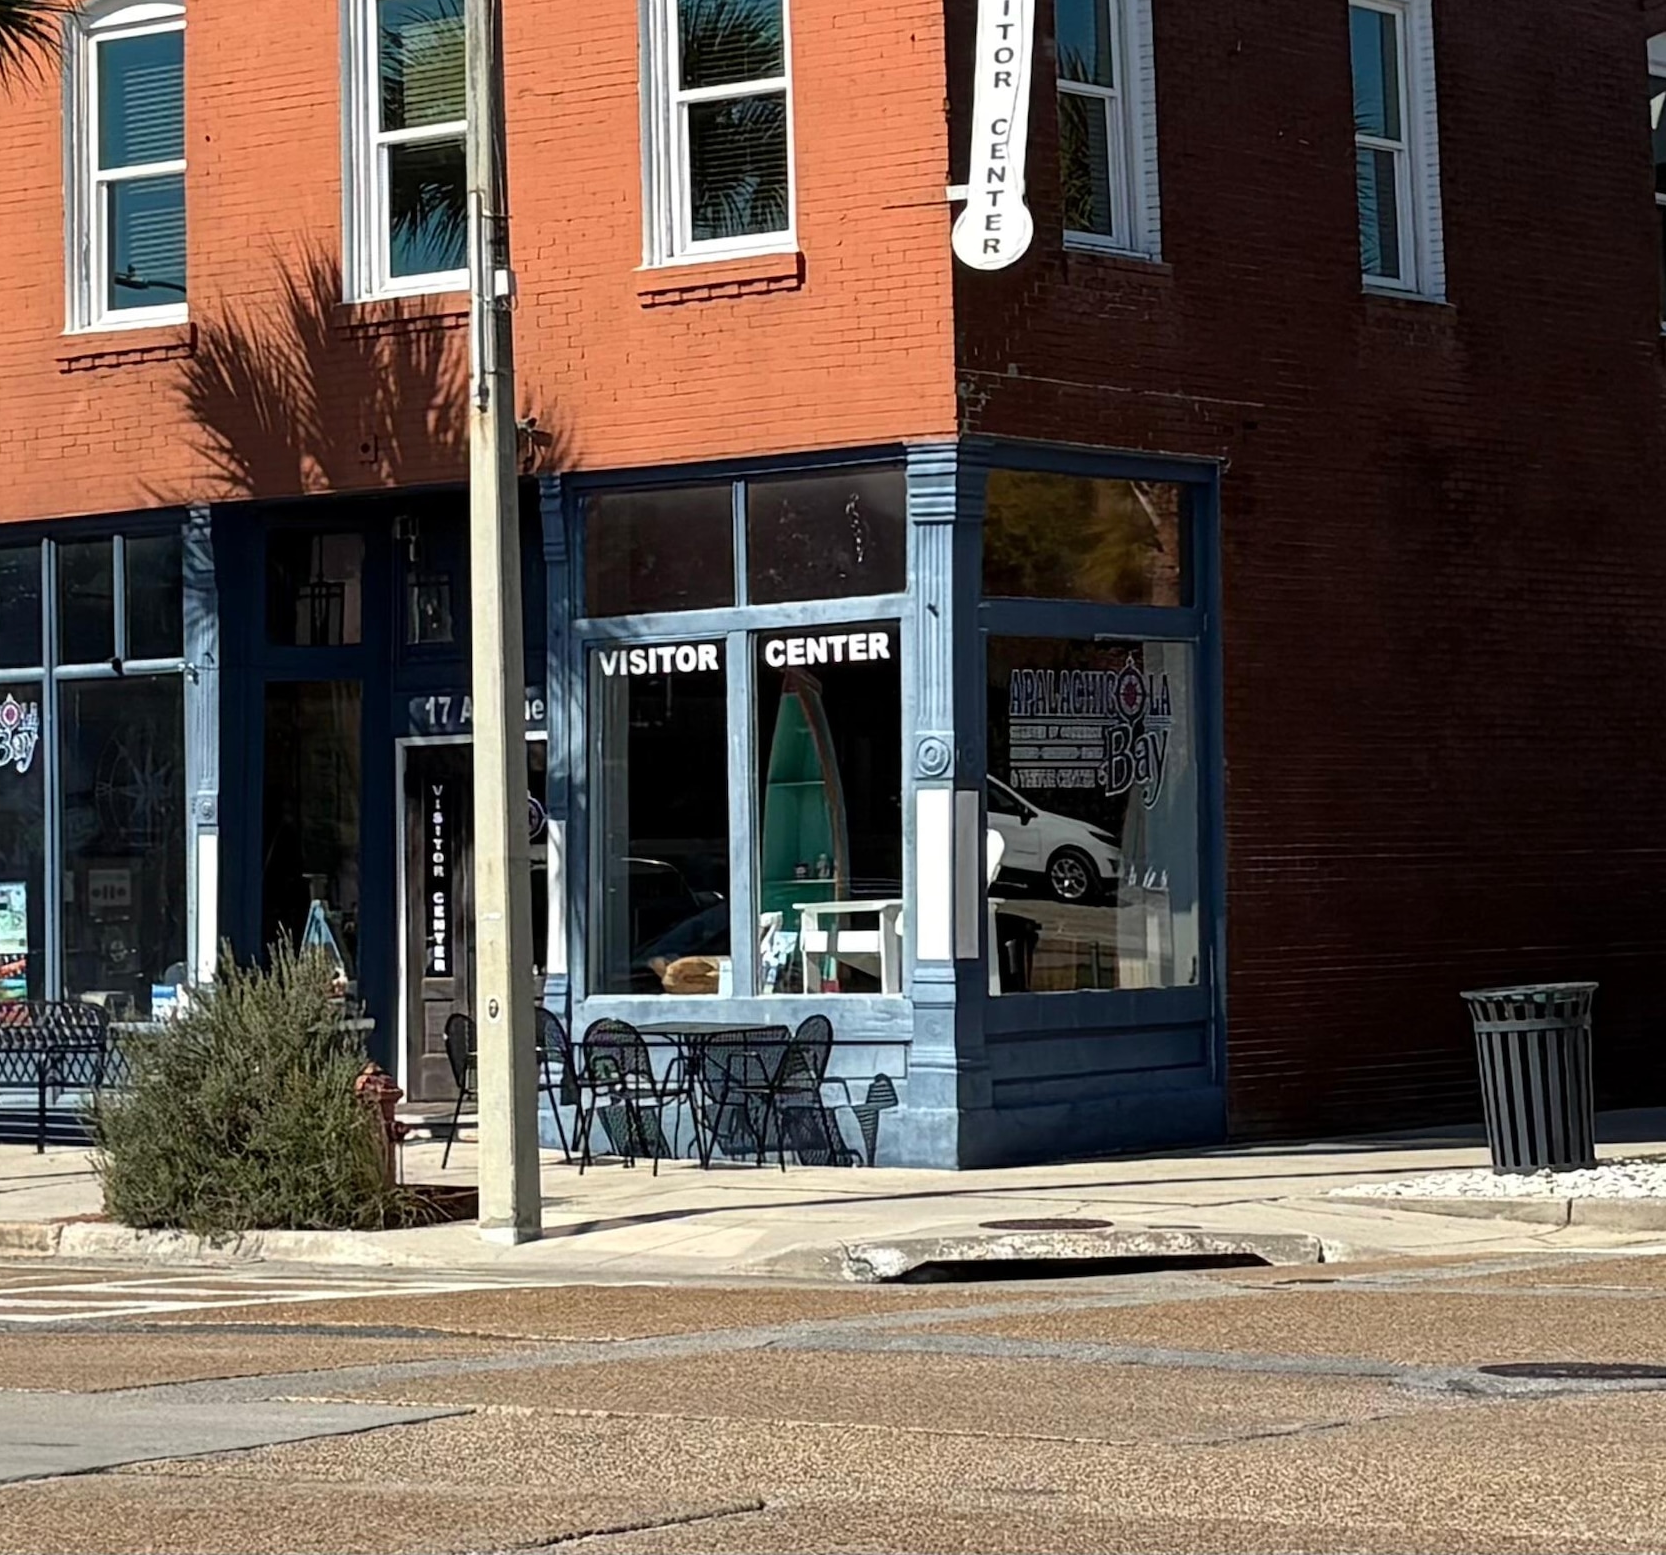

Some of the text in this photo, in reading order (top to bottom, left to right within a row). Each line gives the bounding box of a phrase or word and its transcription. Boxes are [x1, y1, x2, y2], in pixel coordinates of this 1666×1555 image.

[982, 118, 1008, 255] CENTER
[598, 631, 891, 676] VISITOR CENTER
[425, 696, 451, 725] 17
[1099, 724, 1170, 810] Bay
[432, 784, 446, 972] VISITOR CENTER
